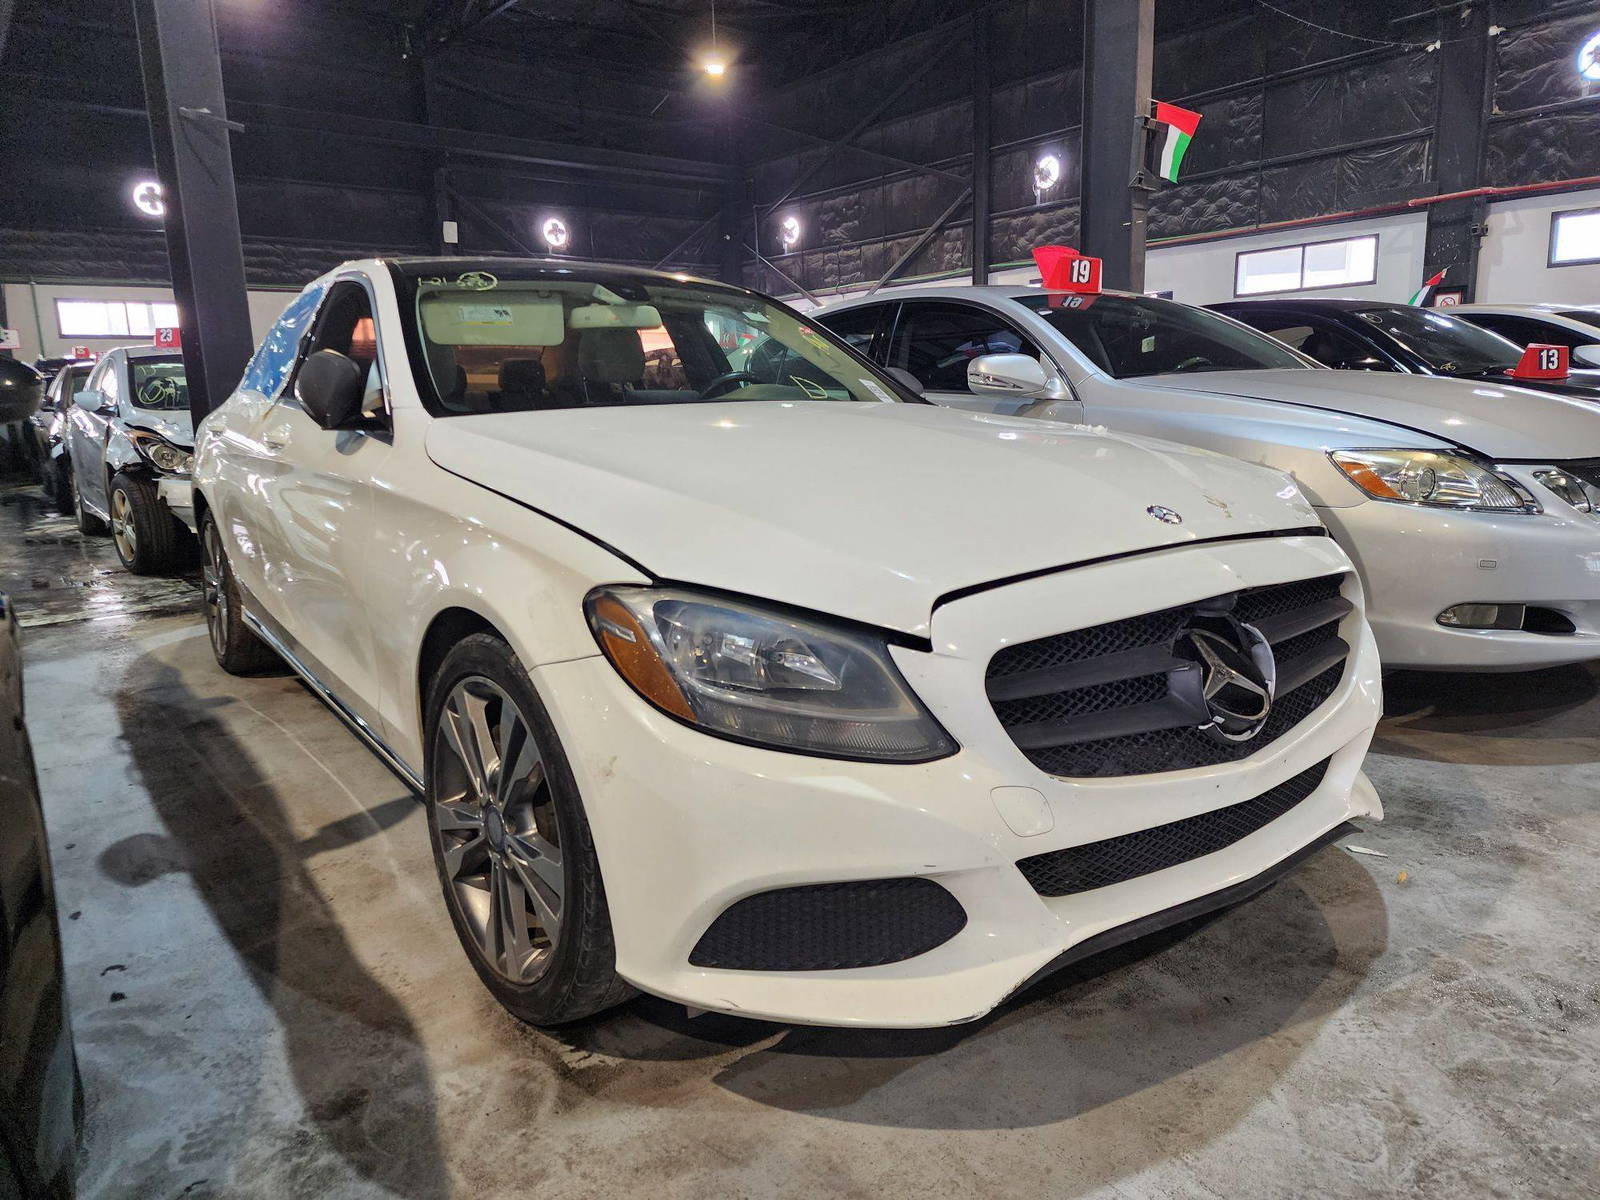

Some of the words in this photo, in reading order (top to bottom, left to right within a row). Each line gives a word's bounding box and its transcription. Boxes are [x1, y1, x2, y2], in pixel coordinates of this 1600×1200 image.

[1072, 259, 1090, 283] 19
[160, 328, 173, 342] 23
[1540, 349, 1559, 370] 13
